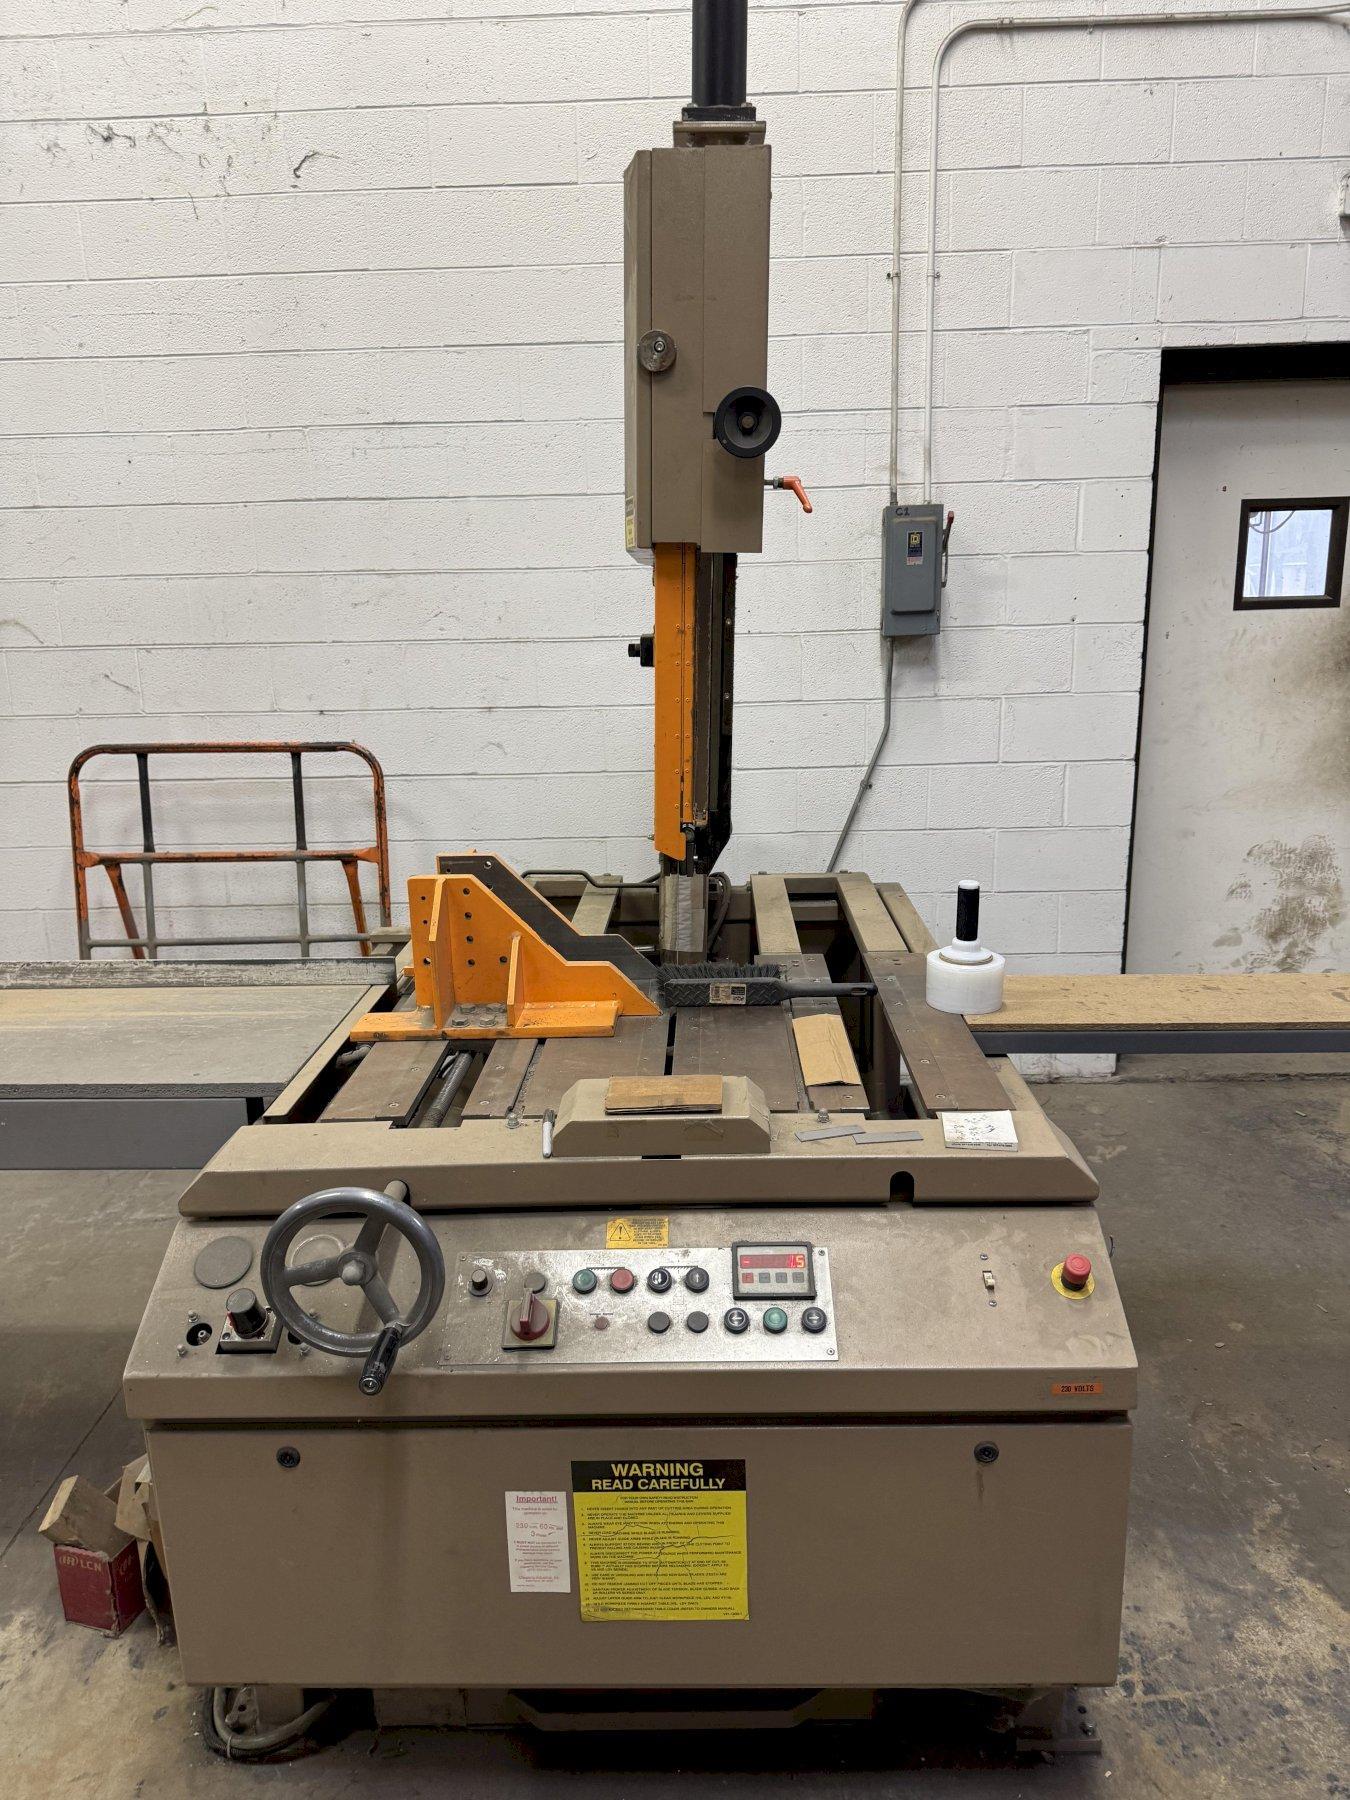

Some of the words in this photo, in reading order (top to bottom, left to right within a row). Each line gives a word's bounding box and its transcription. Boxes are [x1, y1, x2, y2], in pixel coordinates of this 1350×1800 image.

[611, 1463, 704, 1476] WARNING
[592, 1480, 634, 1490] READ
[638, 1478, 726, 1490] CAREFULLY
[516, 1496, 557, 1504] Important!
